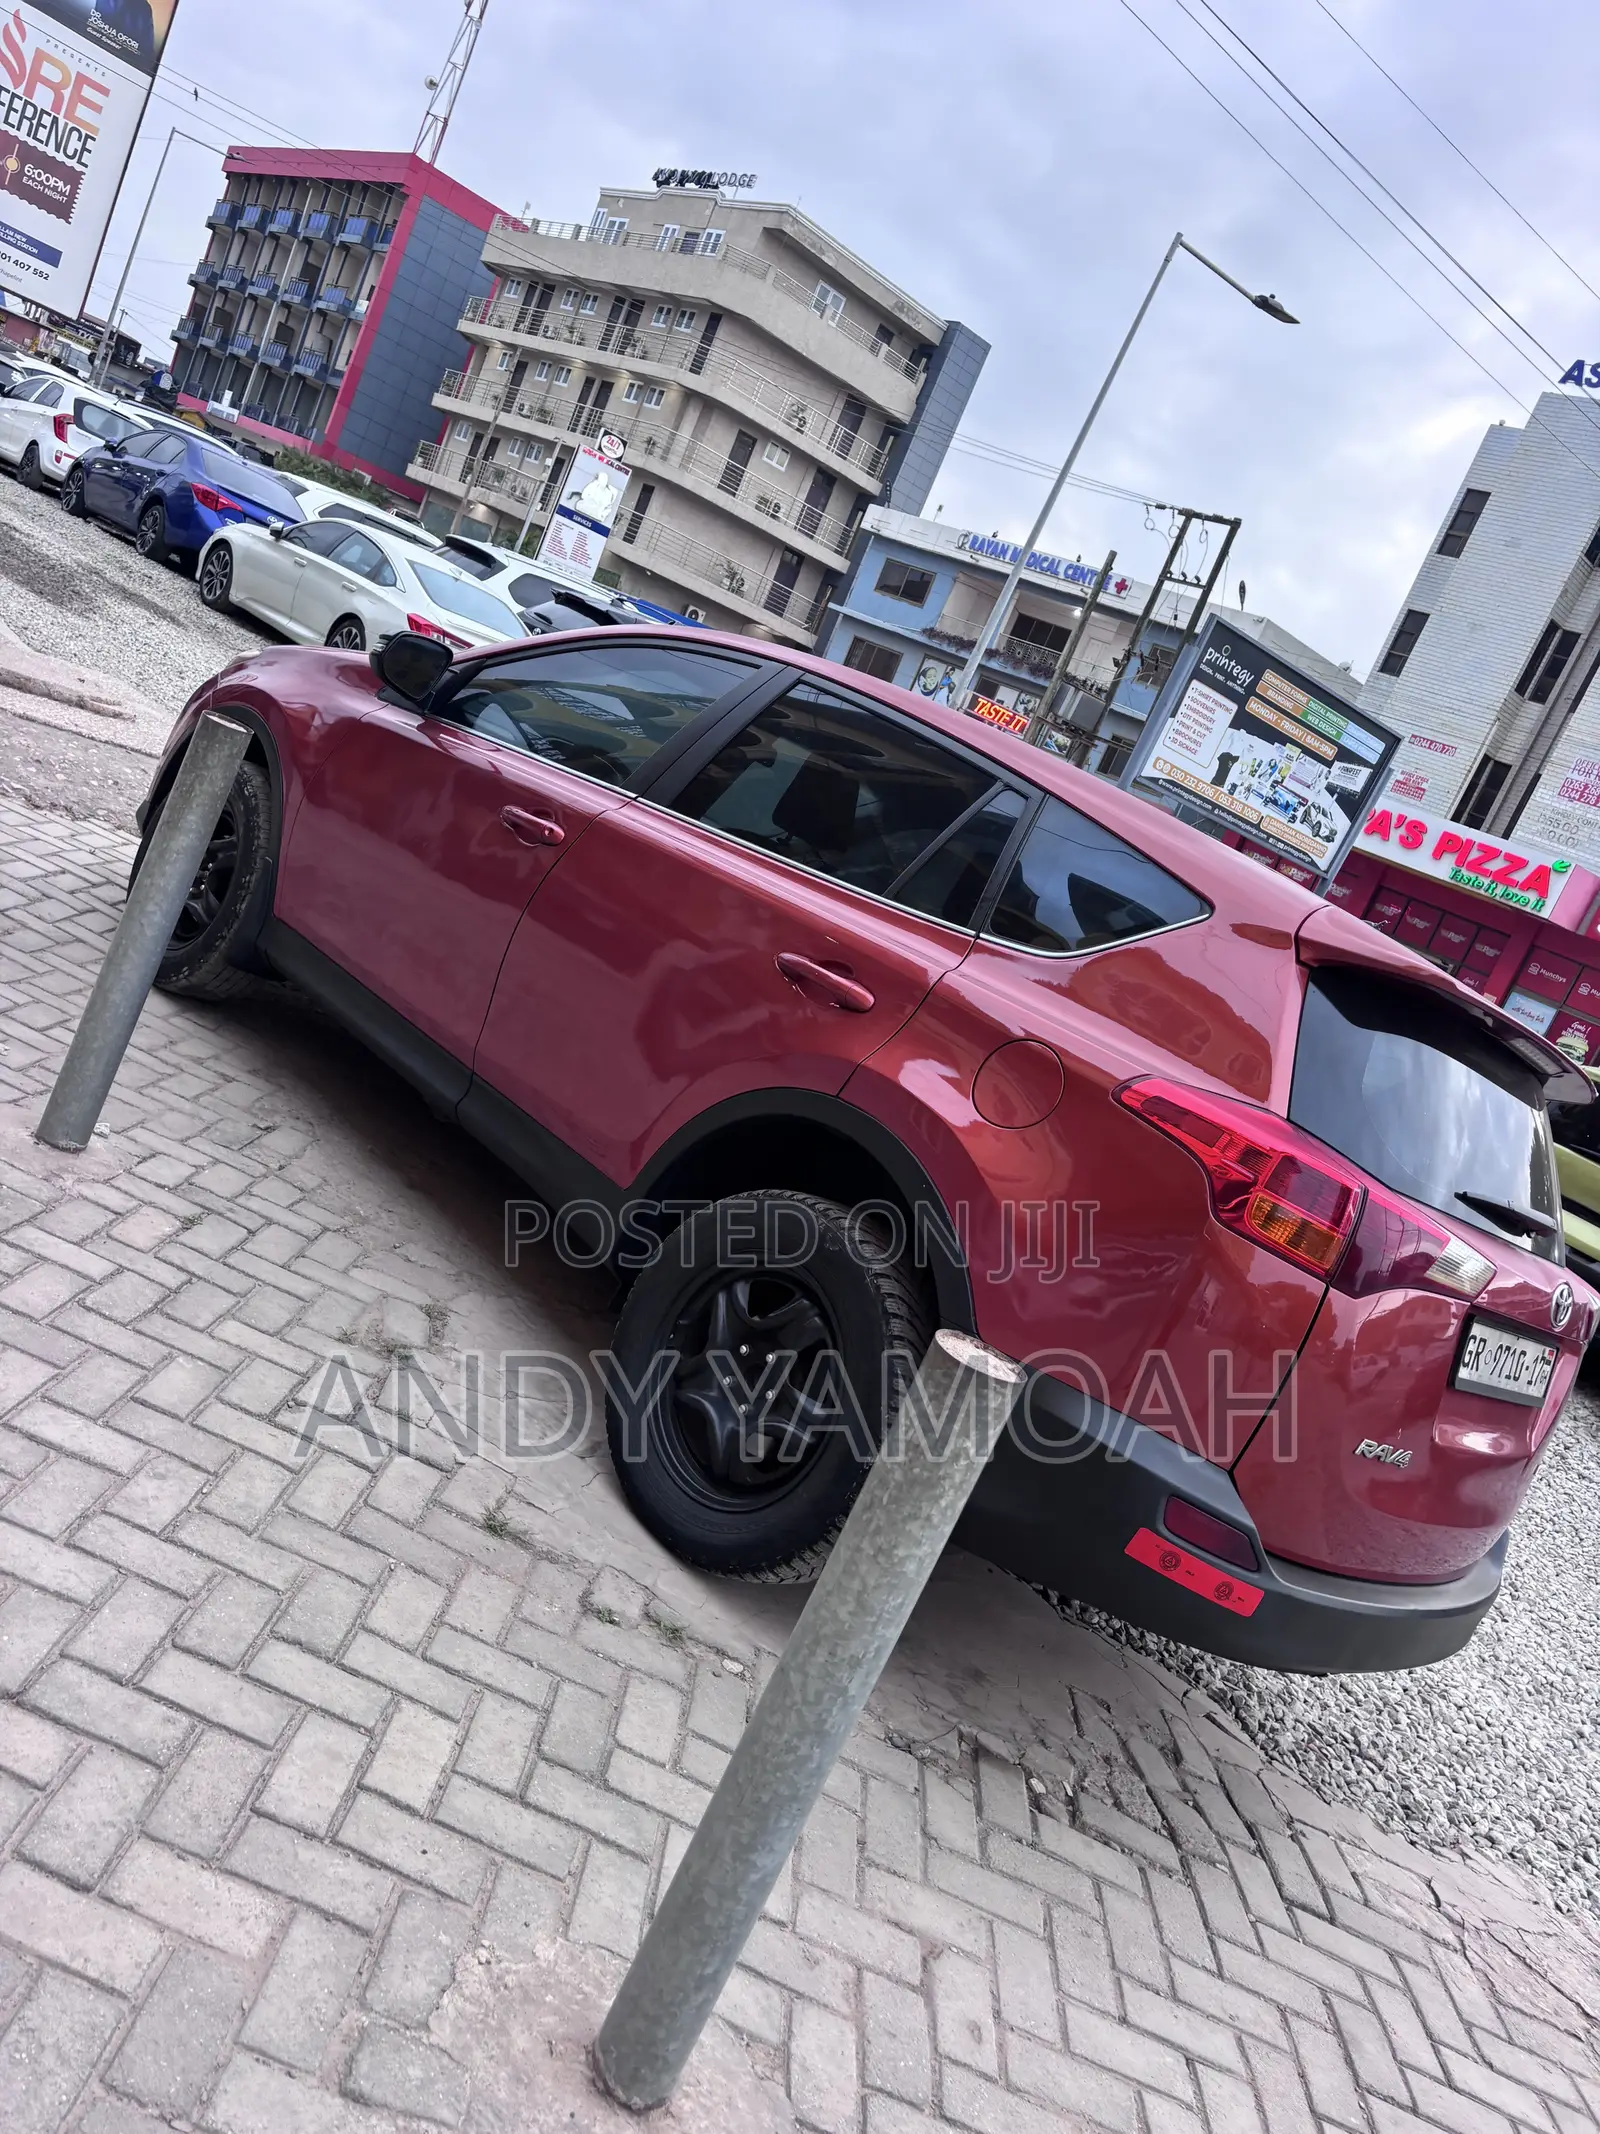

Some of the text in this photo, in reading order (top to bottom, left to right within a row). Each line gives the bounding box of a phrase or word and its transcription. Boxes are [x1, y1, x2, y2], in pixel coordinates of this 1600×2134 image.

[88, 16, 117, 37] JOSHUA
[117, 32, 140, 49] OFORI
[45, 38, 107, 77] PRESENTS
[22, 176, 68, 204] EACH NIGHT
[24, 163, 71, 196] 6:00PM
[12, 259, 32, 272] 407
[32, 267, 50, 281] 552
[1558, 359, 1600, 388] AS
[606, 435, 621, 450] 24/7
[572, 514, 593, 528] SERVICES
[968, 535, 1113, 591] RAYAN MDICAL CENTE
[1202, 645, 1255, 687] printegy
[974, 698, 1028, 731] TASTE IT
[1186, 704, 1216, 725] EMBROIDERY
[1190, 696, 1216, 715] SOUVENIRS
[1194, 687, 1233, 715] T-SHIRT PRINTING
[1265, 673, 1348, 729] COMPUTER FORMS DIGITAL PRINTING
[1266, 690, 1294, 710] BRANDING
[1307, 714, 1320, 727] WEB
[1178, 720, 1193, 732] PRINT
[1196, 730, 1207, 740] CUT
[1191, 717, 1214, 734] PRINTING
[1249, 701, 1278, 722] MONDAY
[1280, 721, 1303, 737] FRIDAY
[1174, 728, 1203, 748] BROCHURES
[1415, 737, 1430, 749] 0244
[1430, 742, 1443, 752] 470
[1571, 765, 1593, 778] FOR
[1575, 757, 1600, 773] OFFIC
[1171, 769, 1185, 781] 030
[1184, 775, 1197, 788] 232
[1231, 800, 1243, 811] 318
[1560, 787, 1580, 800] 0244
[1580, 793, 1597, 805] 278
[1565, 778, 1586, 791] 0265
[1364, 808, 1427, 849] A'S
[1431, 831, 1551, 899] PIZZA
[1449, 867, 1484, 890] Taste
[1499, 884, 1530, 907] love
[1530, 897, 1546, 912] it
[1540, 967, 1567, 983] Munchys
[1462, 1334, 1488, 1372] GR
[1354, 1438, 1413, 1468] RAV4
